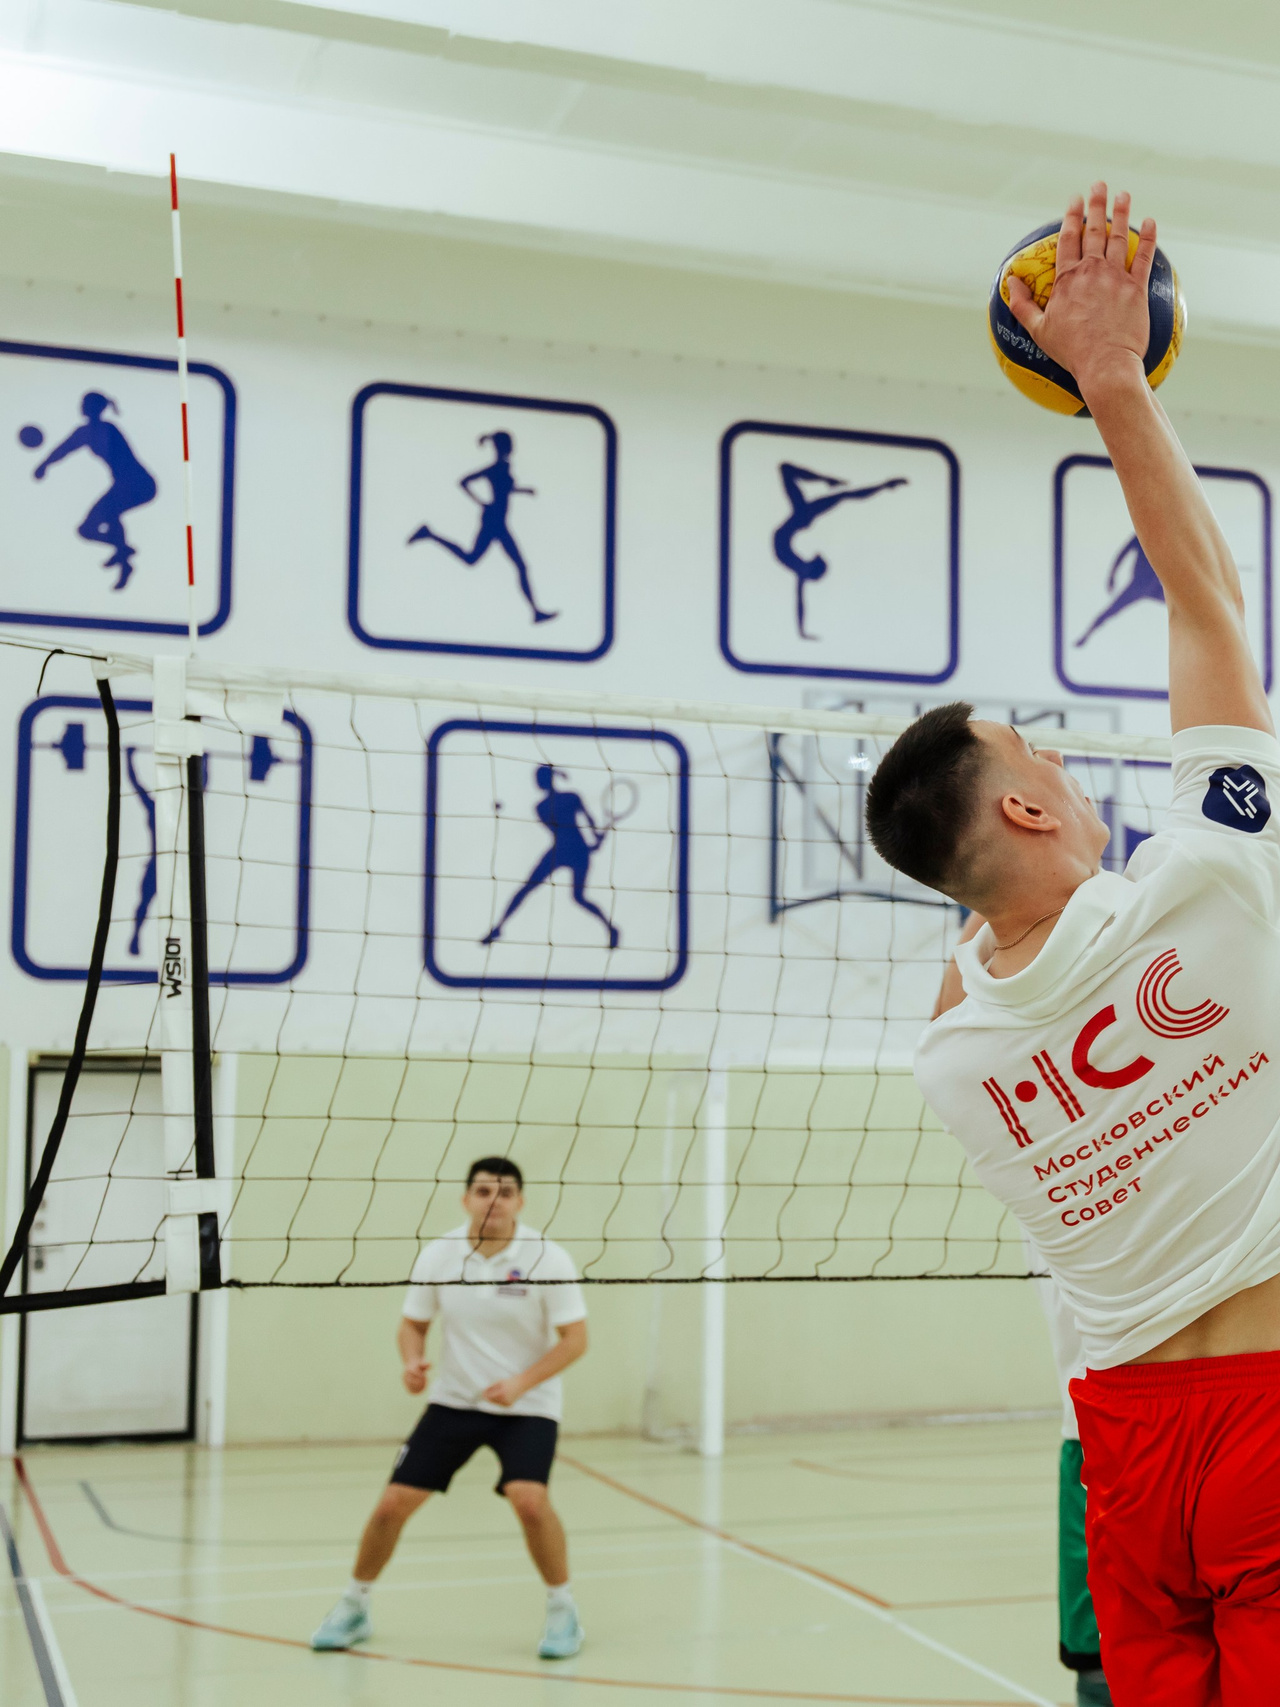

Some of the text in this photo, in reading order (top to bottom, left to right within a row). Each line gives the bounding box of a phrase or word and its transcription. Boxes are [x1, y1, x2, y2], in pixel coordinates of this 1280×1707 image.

[1033, 1053, 1225, 1181] Московский
[1048, 1051, 1270, 1203] Студенческий
[1061, 1176, 1142, 1227] Совет
